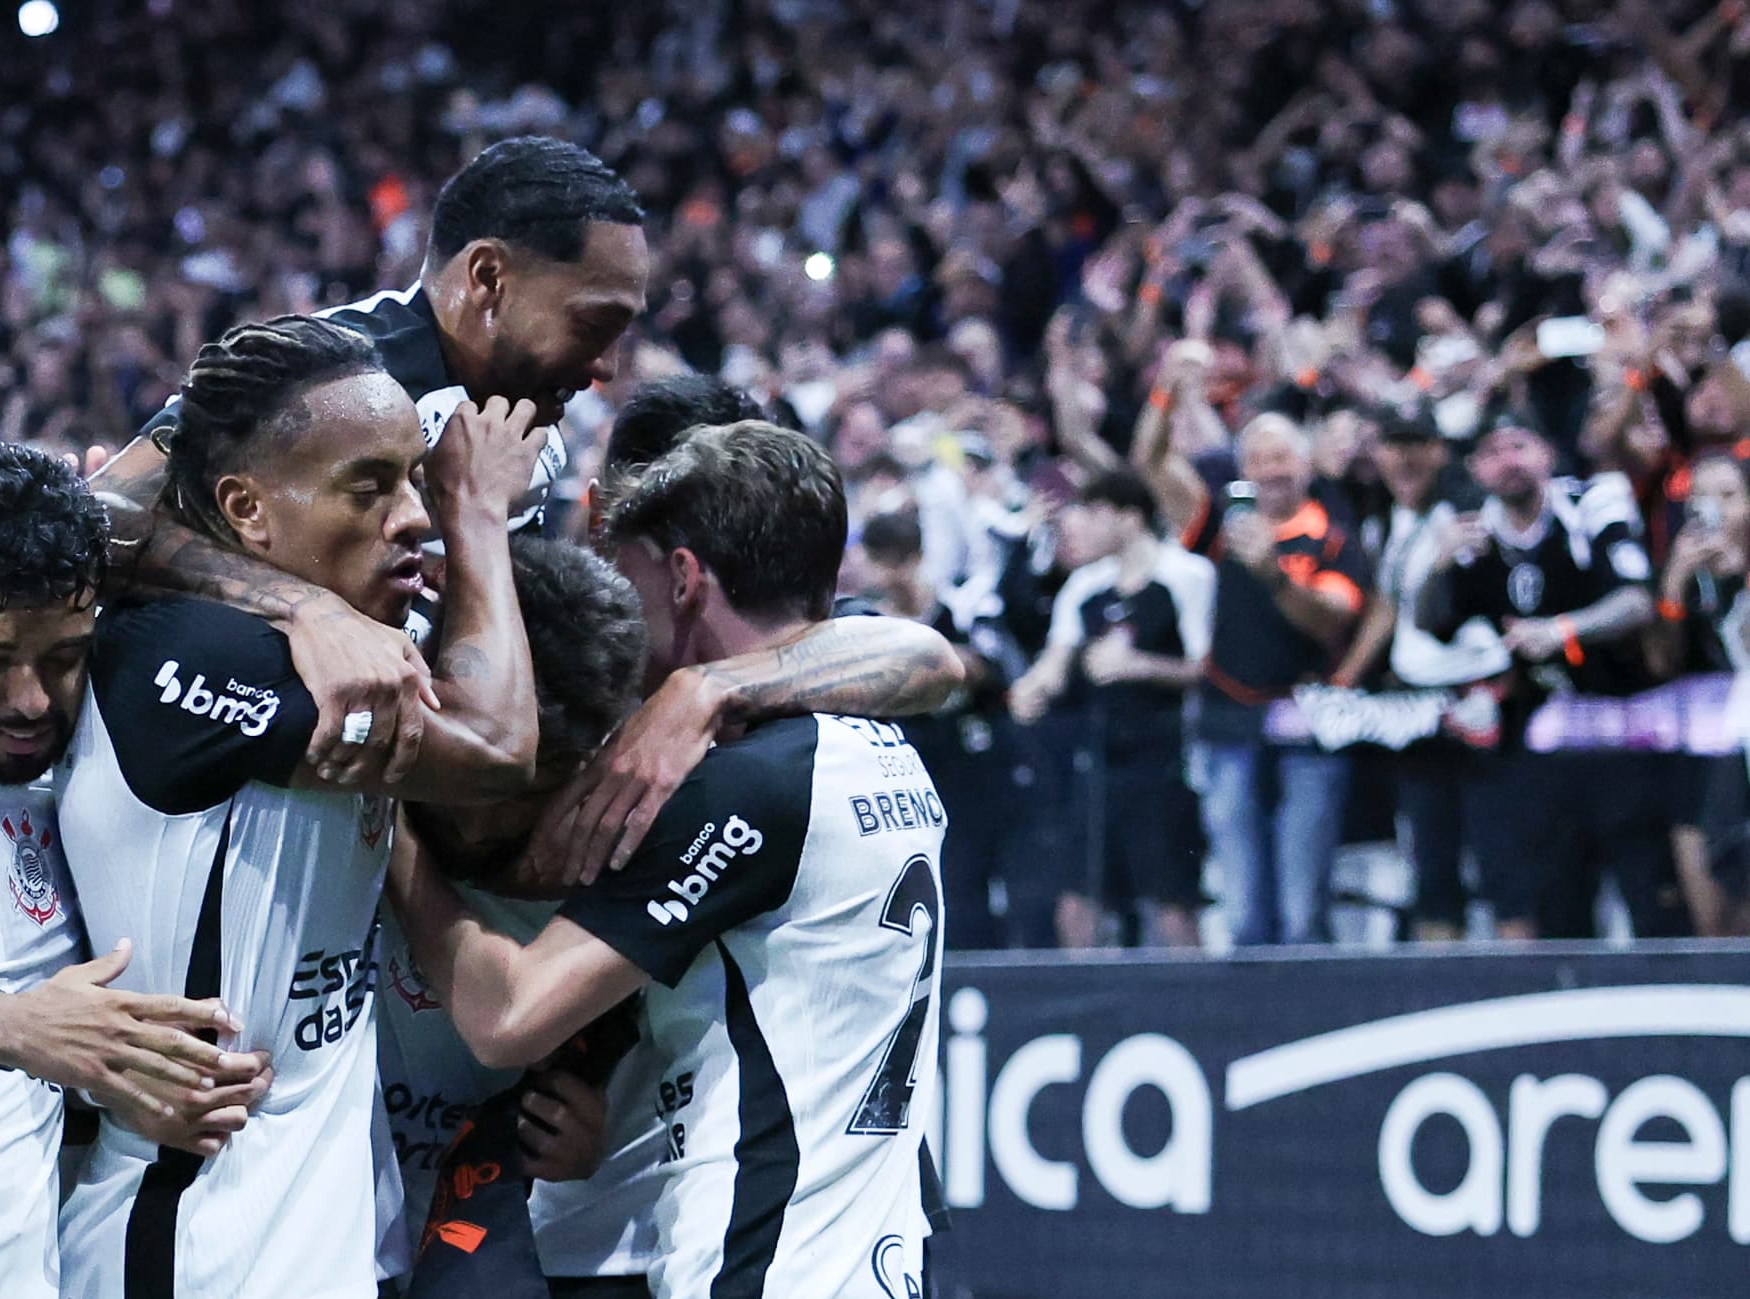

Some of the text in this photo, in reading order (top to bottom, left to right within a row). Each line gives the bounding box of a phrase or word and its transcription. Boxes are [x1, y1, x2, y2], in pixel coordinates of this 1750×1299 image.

[180, 673, 281, 737] bmg
[679, 822, 716, 865] banco
[848, 786, 944, 838] BRENO
[667, 814, 764, 906] bmg
[938, 986, 1215, 1215] ica
